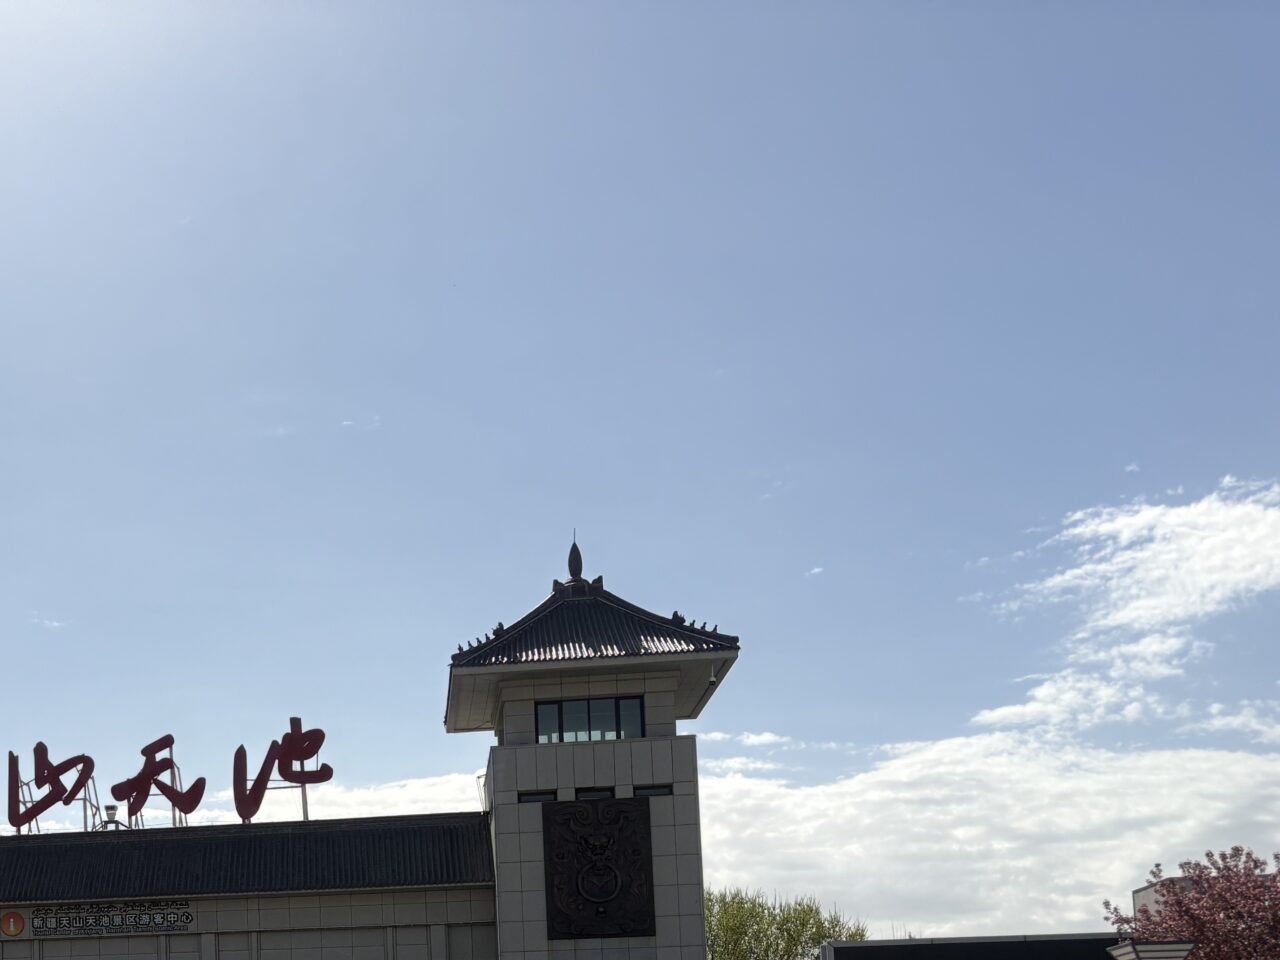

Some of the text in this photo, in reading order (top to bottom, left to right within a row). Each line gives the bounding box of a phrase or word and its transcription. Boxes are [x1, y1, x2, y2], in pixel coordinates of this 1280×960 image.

[32, 912, 193, 929] 新疆天山天池景区游客中心
